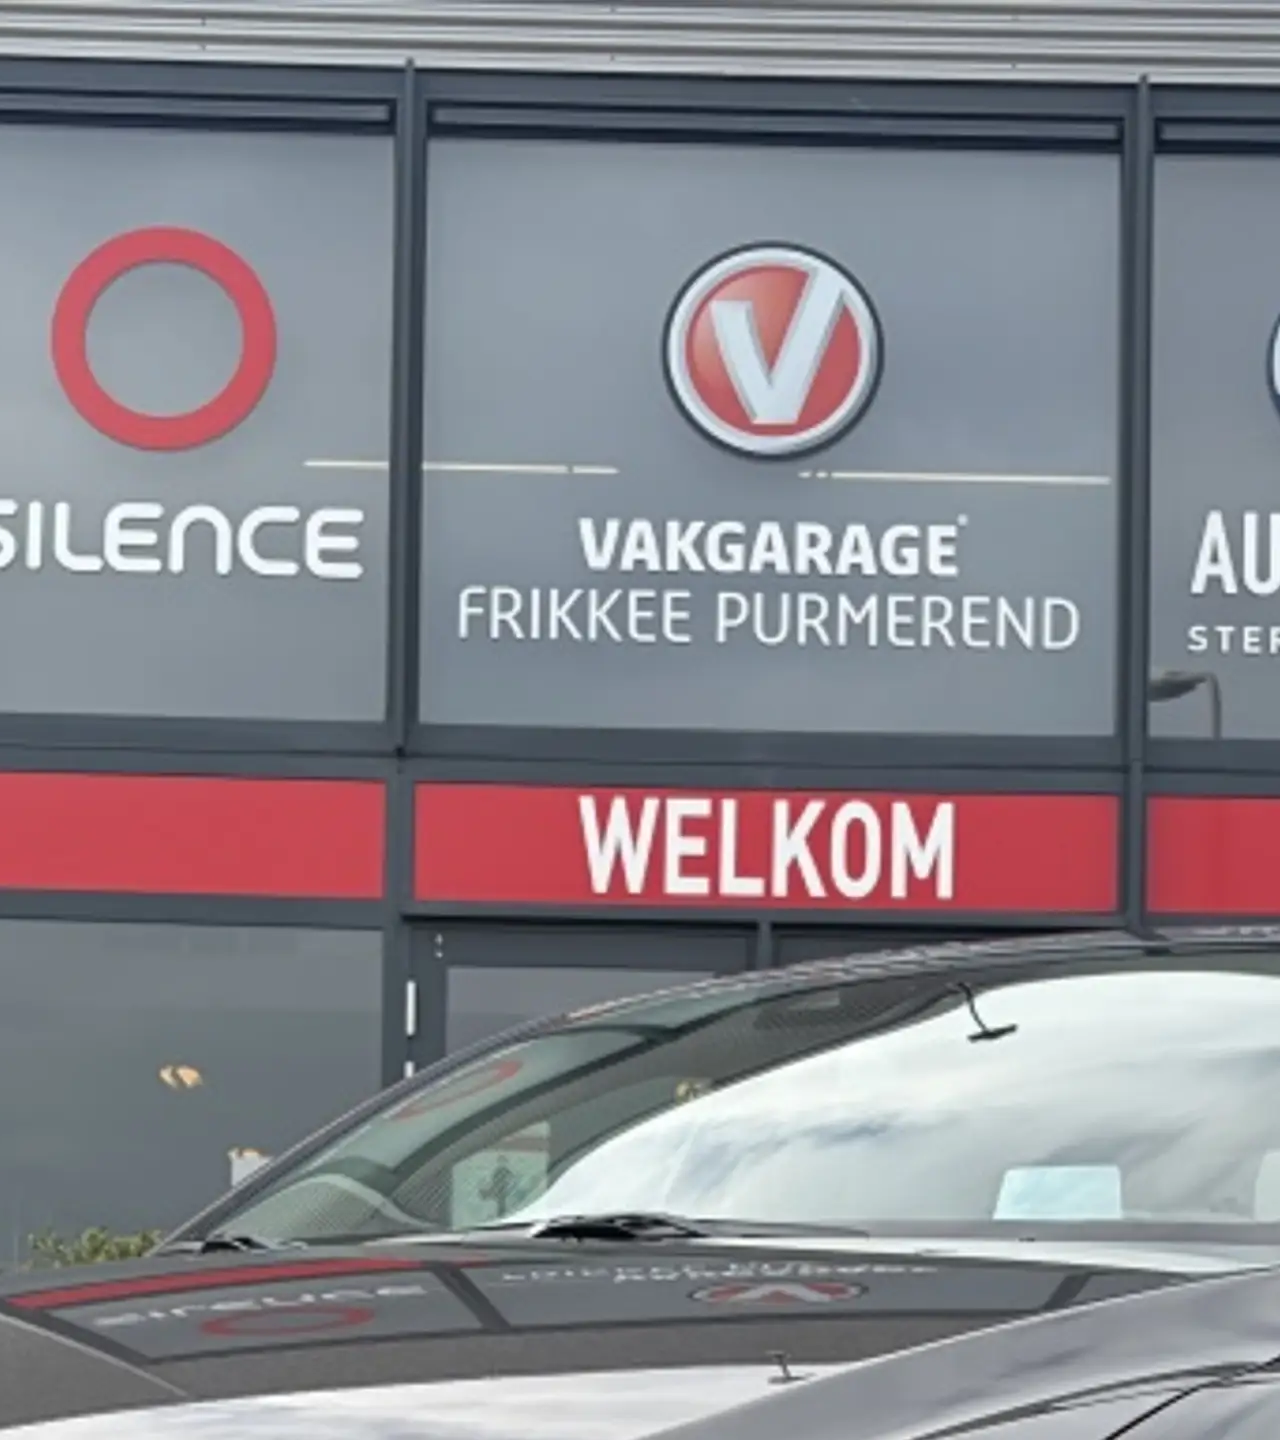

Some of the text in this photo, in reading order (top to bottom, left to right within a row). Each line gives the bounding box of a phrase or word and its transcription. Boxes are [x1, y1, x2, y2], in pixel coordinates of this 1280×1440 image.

[456, 585, 1082, 650] FRIKKEE PURMEREND
[577, 793, 956, 899] WELKOM
